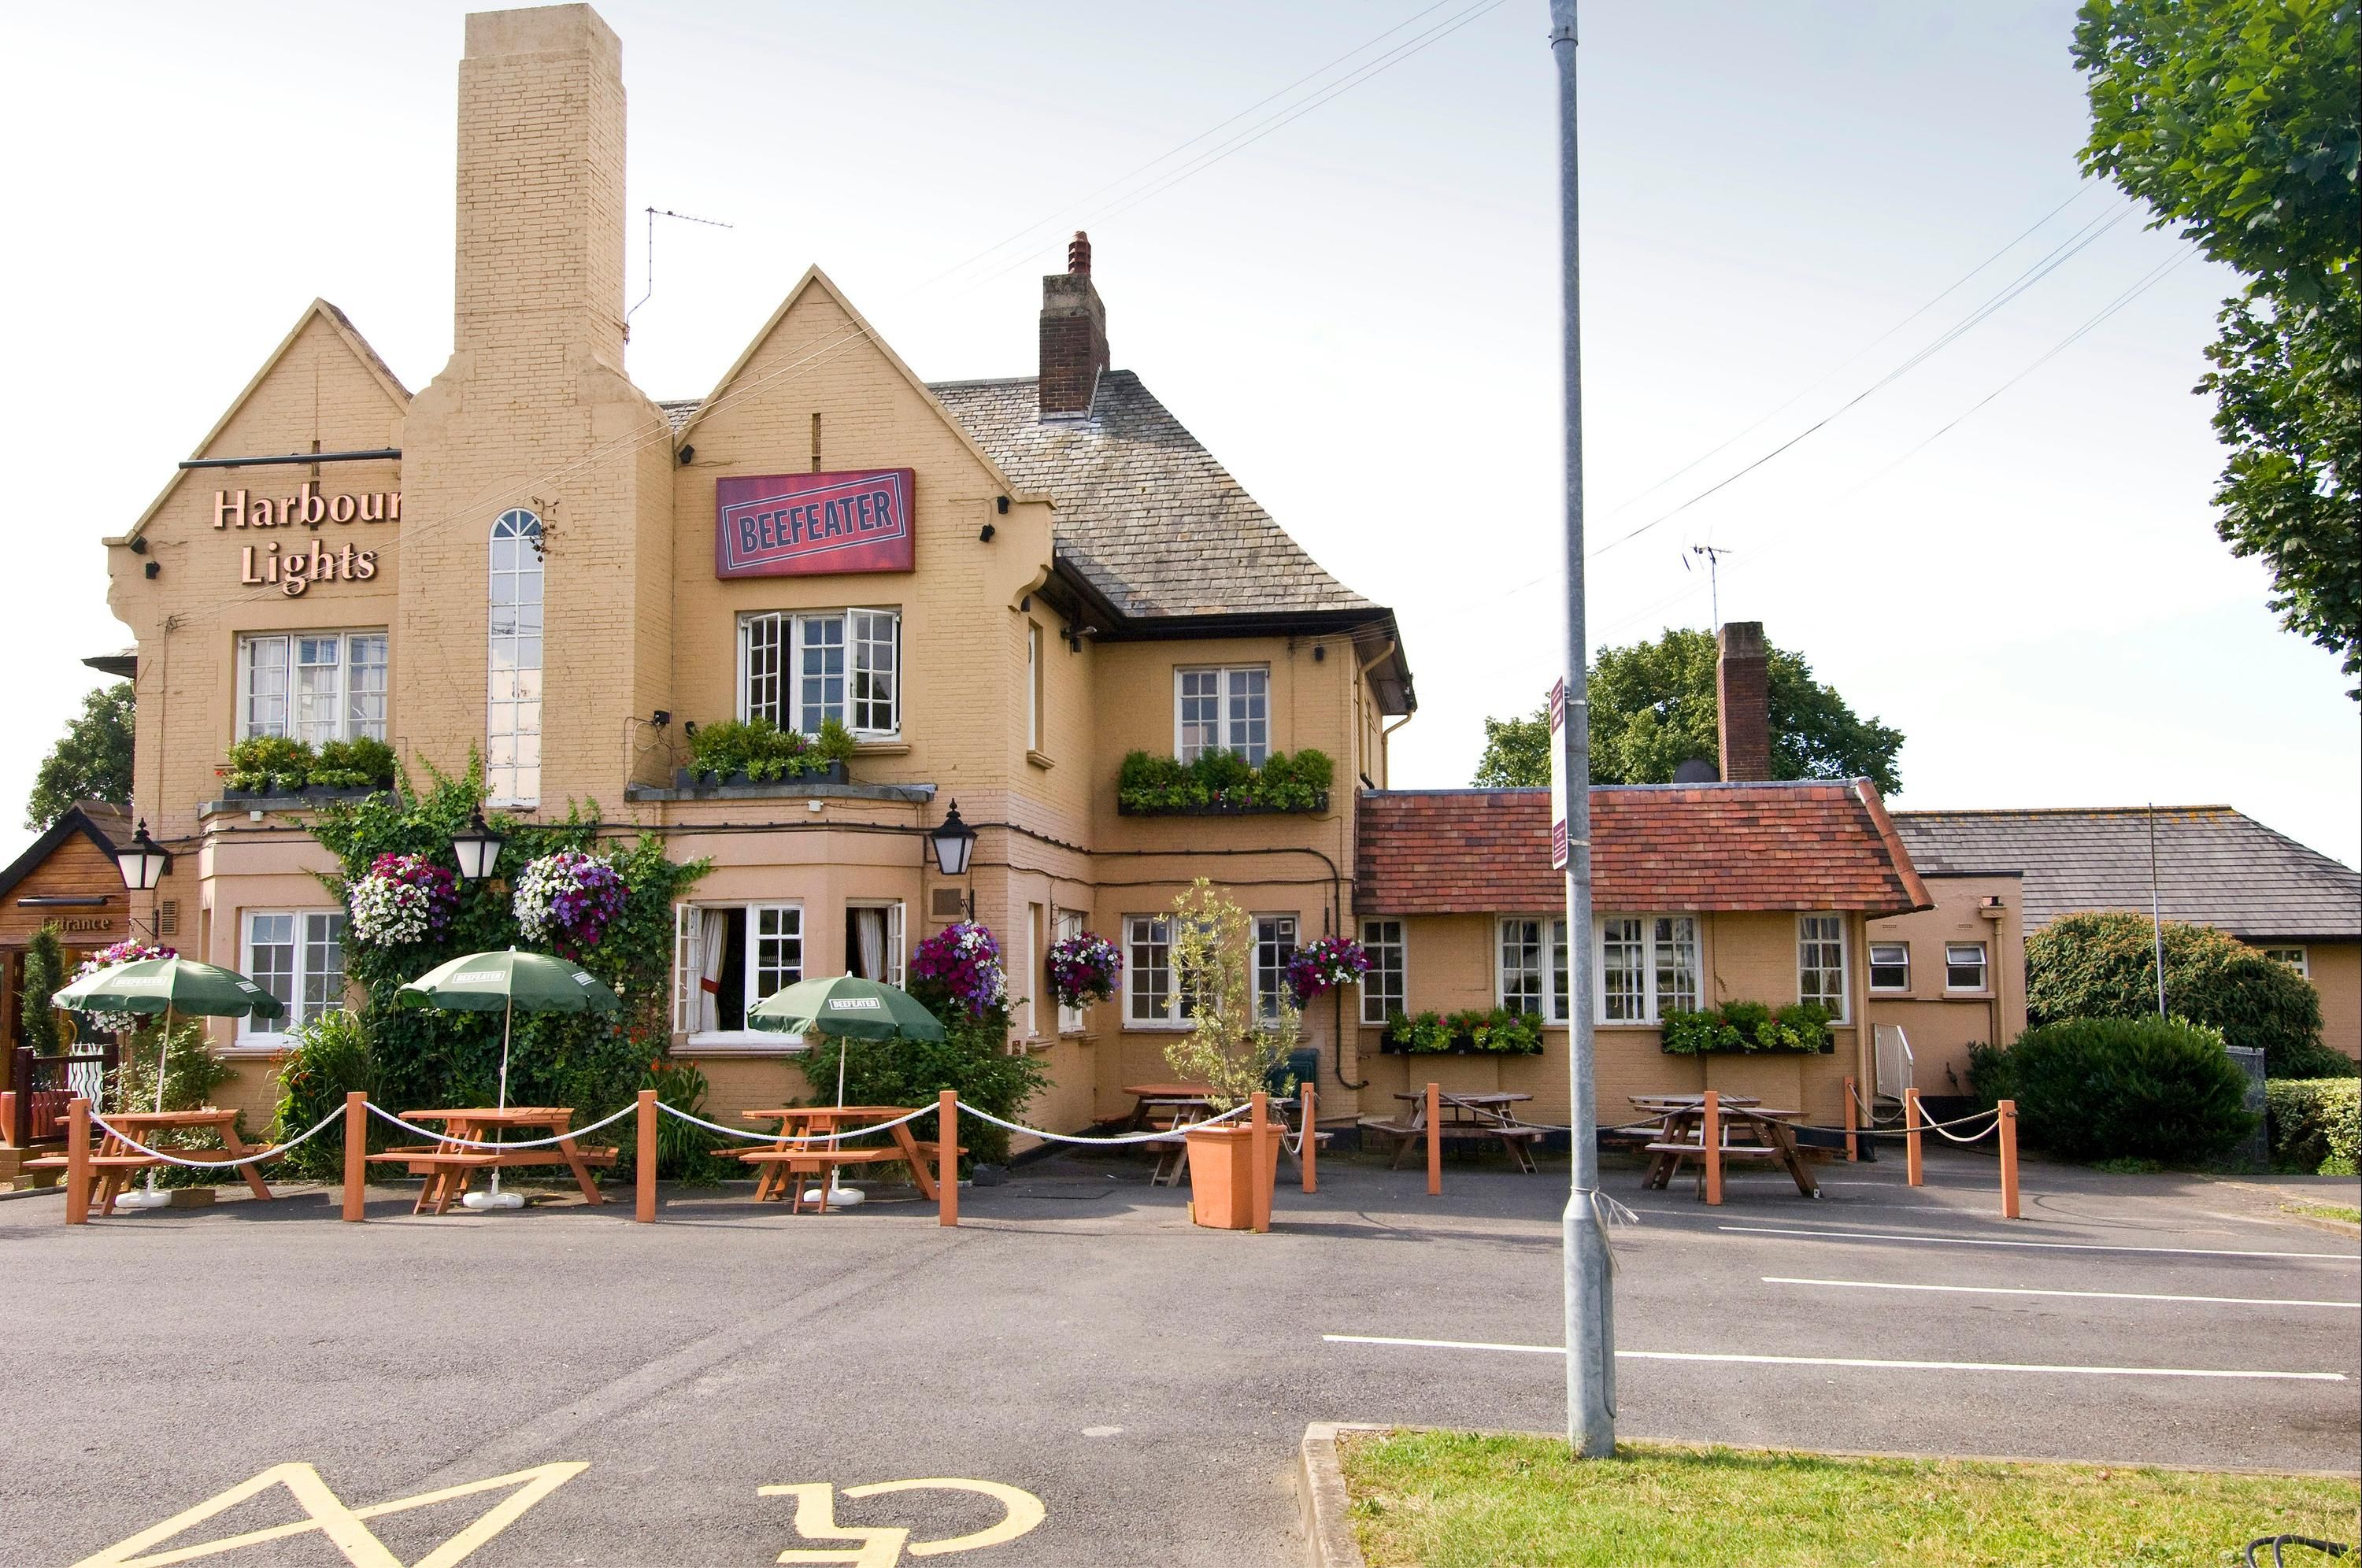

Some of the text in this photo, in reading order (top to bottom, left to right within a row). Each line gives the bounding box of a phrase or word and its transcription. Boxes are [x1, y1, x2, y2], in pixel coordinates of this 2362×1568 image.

[214, 482, 401, 528] Harbour
[739, 490, 894, 555] BEEFEATER
[242, 538, 377, 596] Lights
[832, 1000, 877, 1008] BEEFEATER
